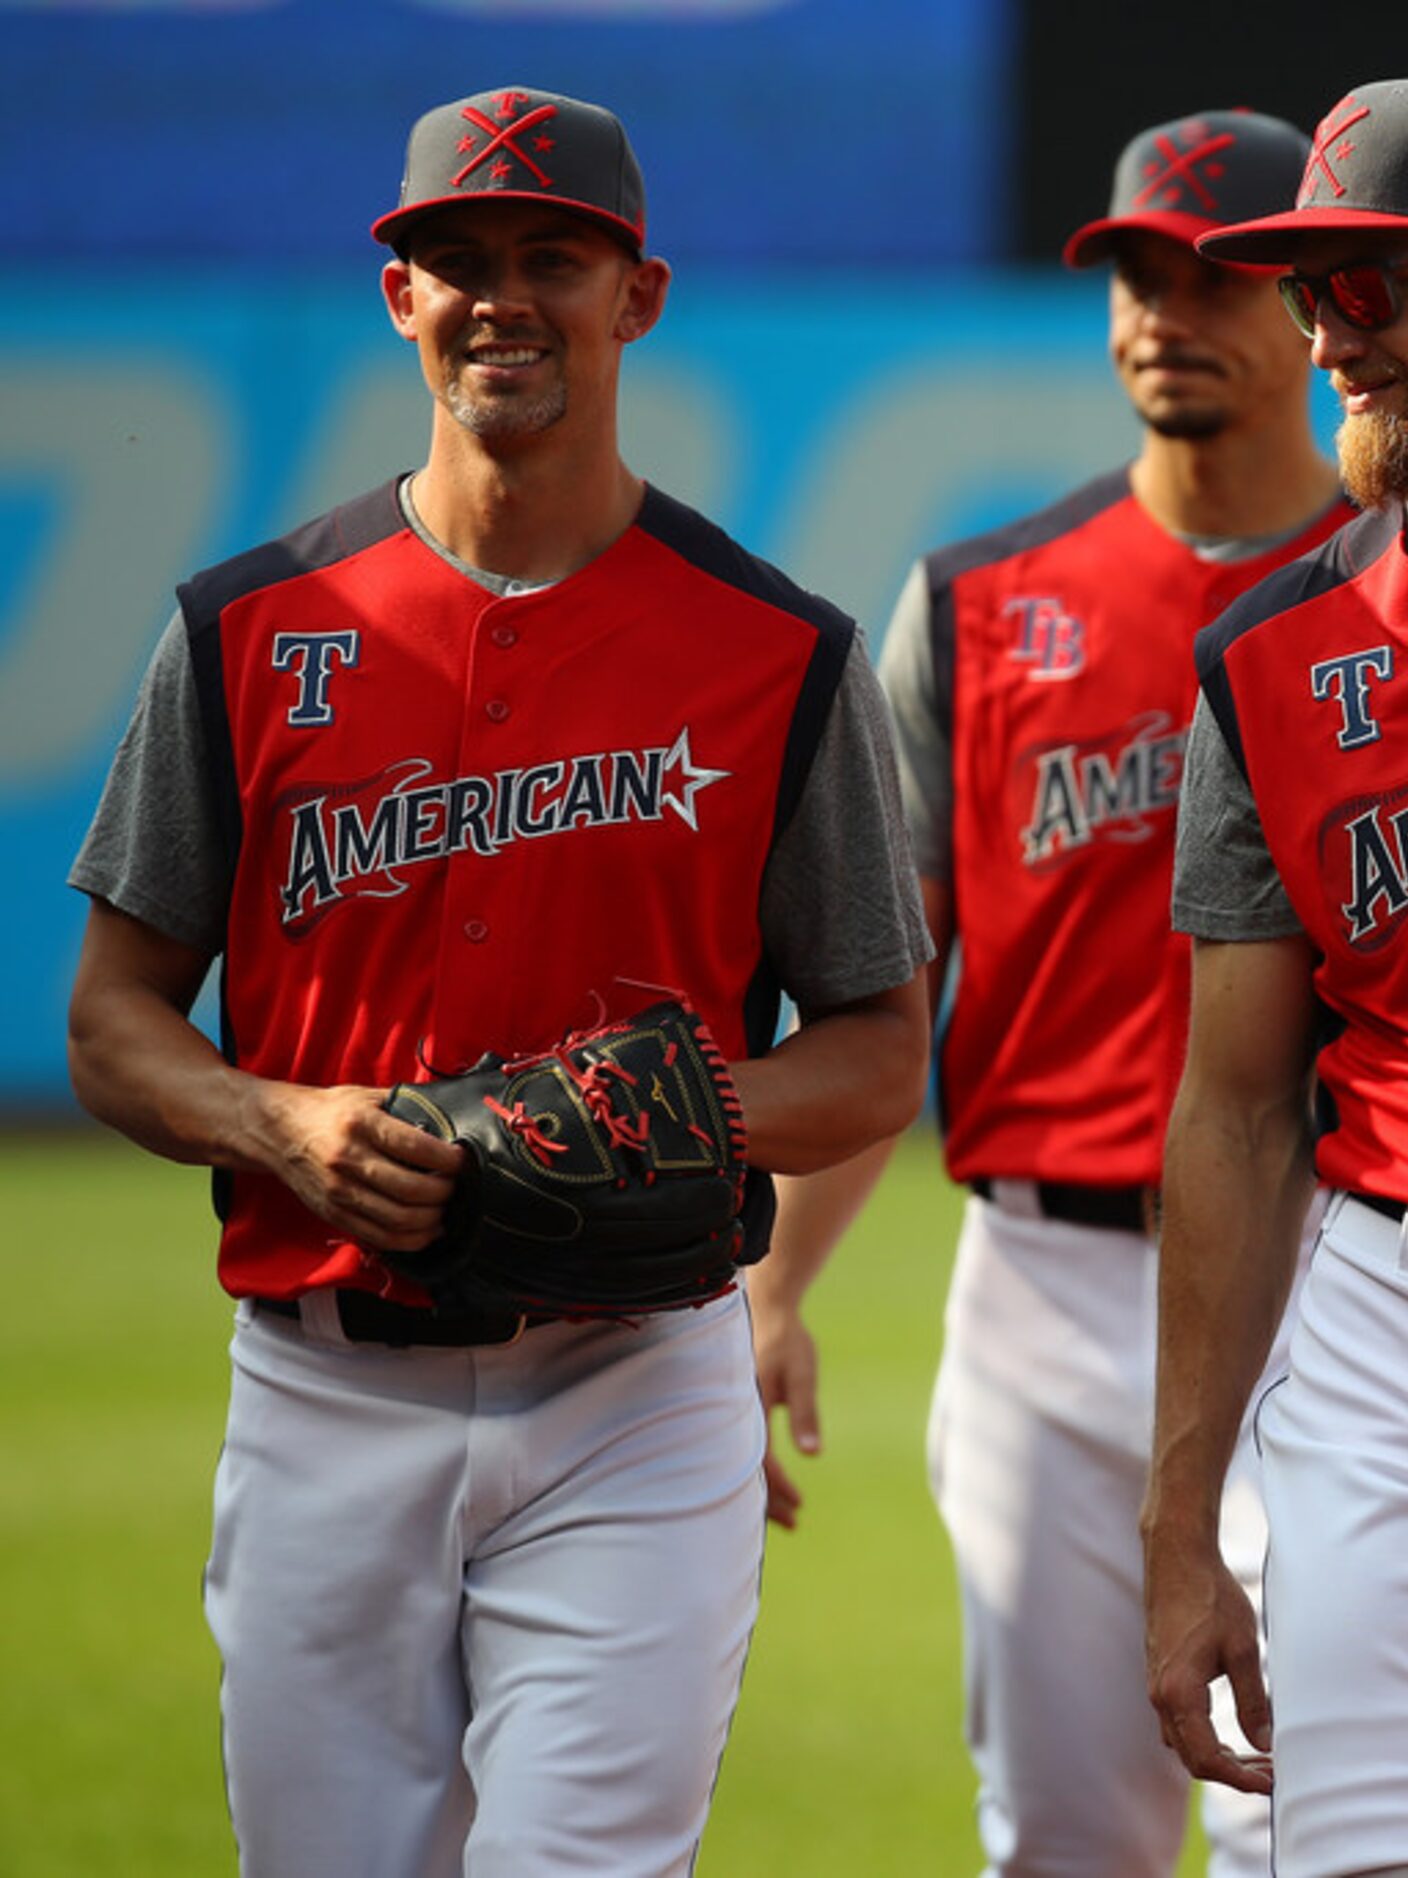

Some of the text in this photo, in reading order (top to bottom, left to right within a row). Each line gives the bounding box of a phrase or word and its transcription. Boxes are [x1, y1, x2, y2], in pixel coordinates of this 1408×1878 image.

[271, 629, 361, 728] T
[1002, 595, 1085, 682] TB
[1311, 645, 1394, 752] T
[281, 746, 670, 923] AMERICAN
